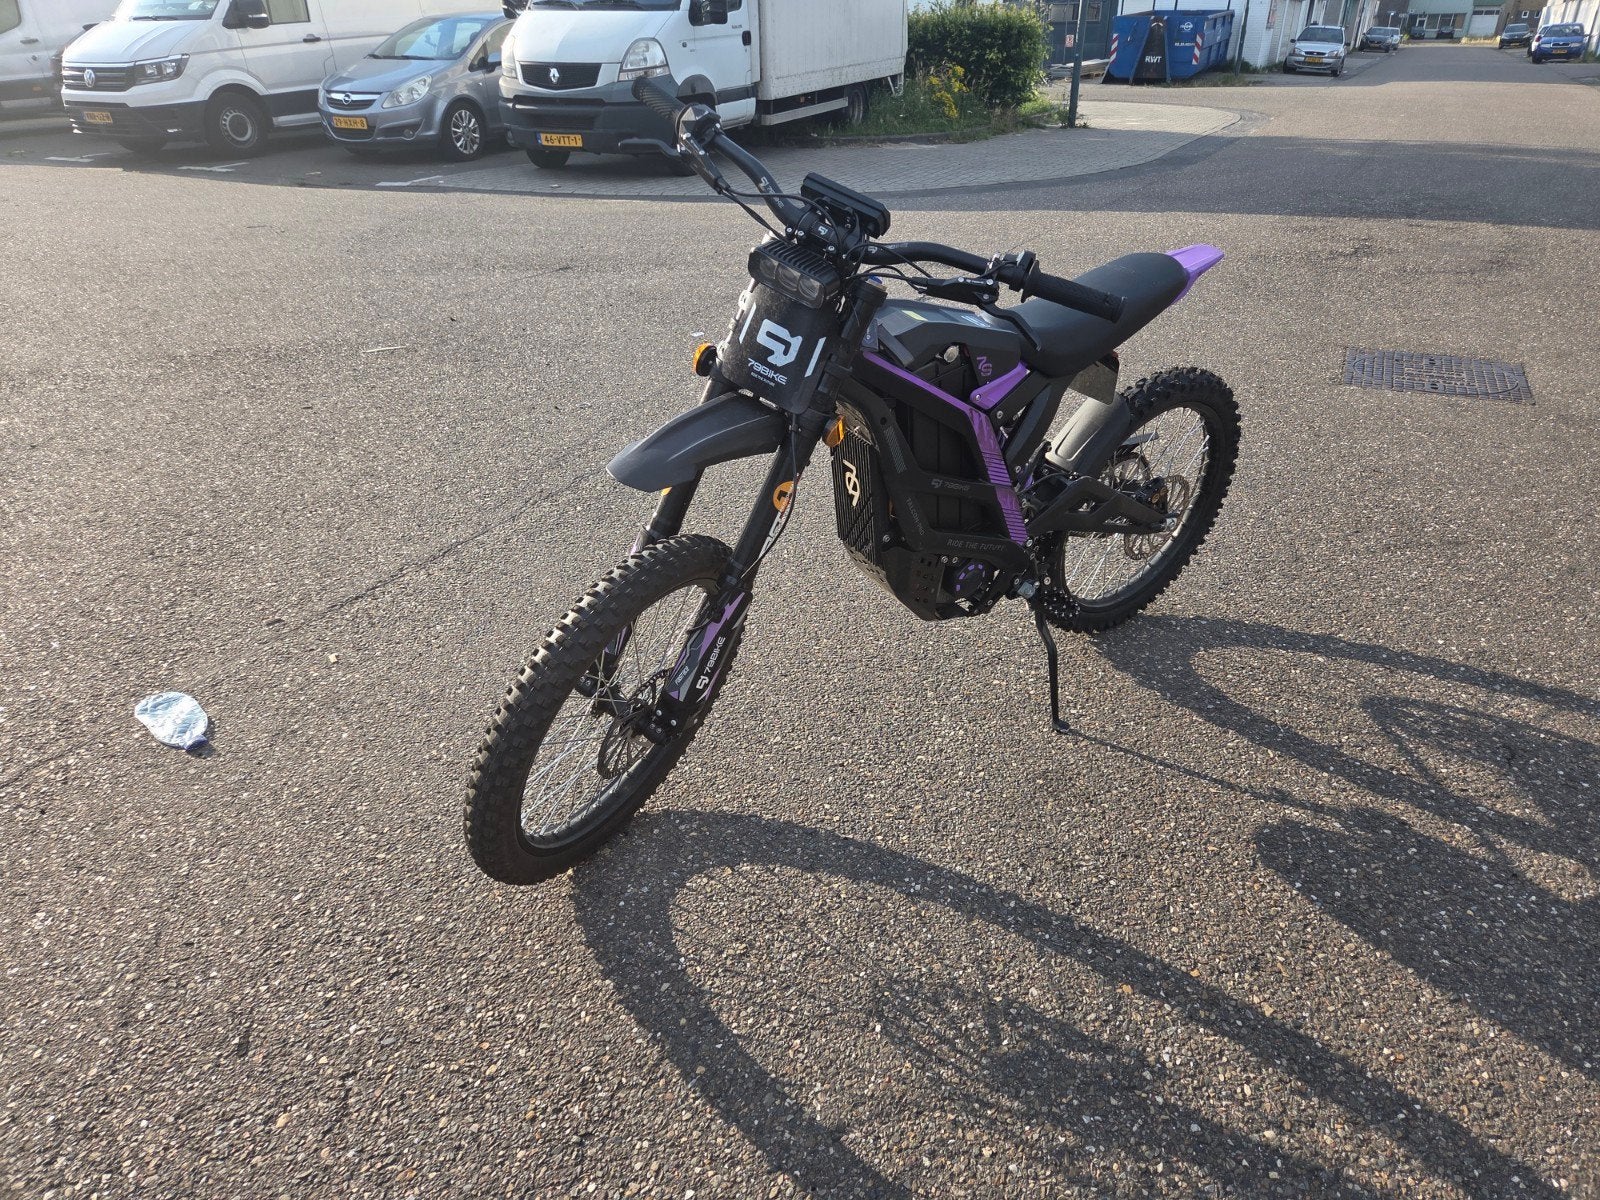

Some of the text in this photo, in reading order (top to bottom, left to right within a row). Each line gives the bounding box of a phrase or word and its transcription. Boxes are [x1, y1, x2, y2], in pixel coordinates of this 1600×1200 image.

[544, 135, 578, 145] 46-VTT-1
[747, 358, 787, 385] 79BIKE
[947, 539, 963, 549] RIDE
[965, 542, 979, 550] THE
[704, 636, 726, 673] 79BIKE
